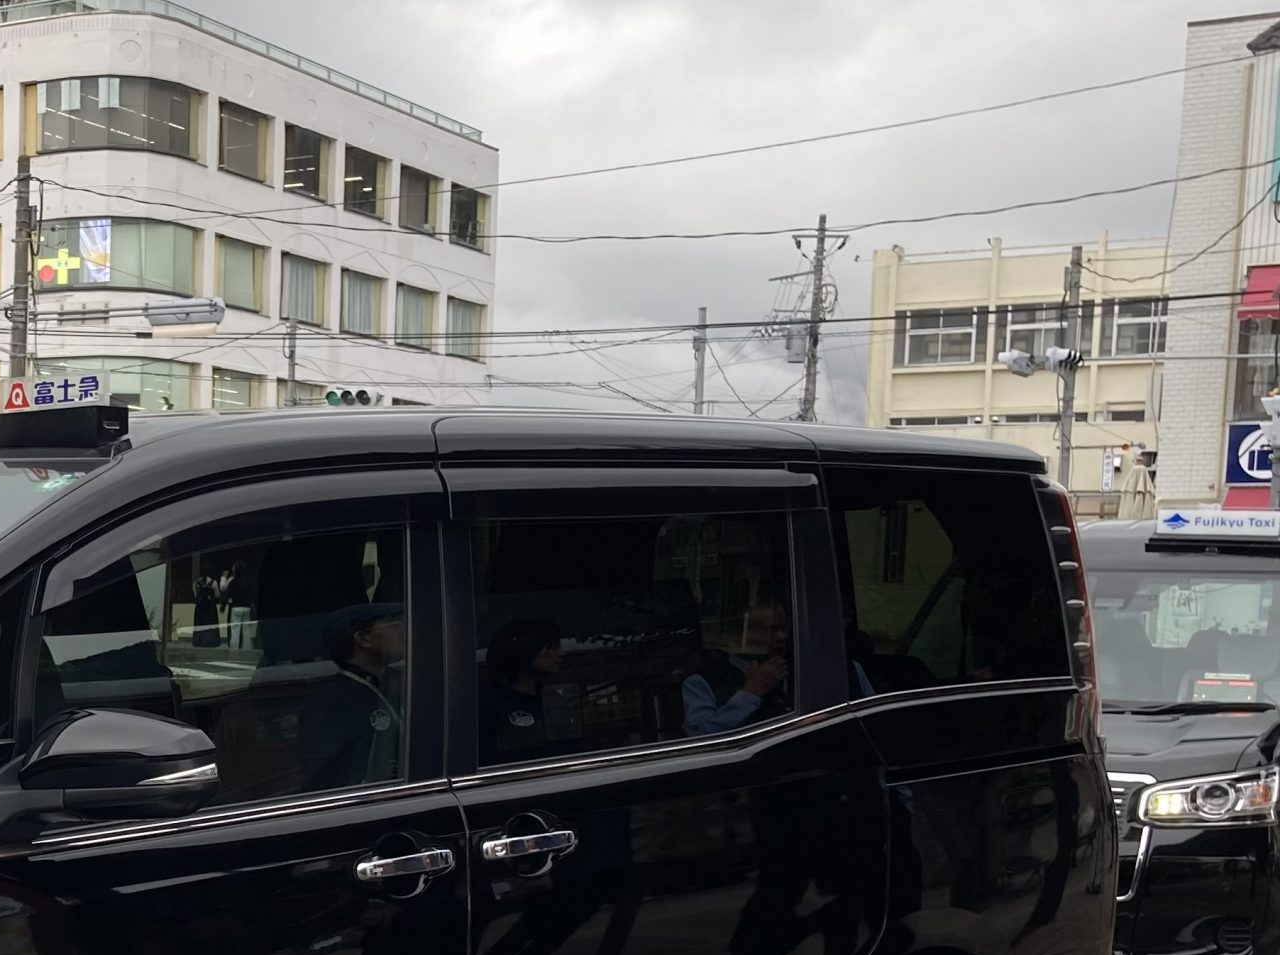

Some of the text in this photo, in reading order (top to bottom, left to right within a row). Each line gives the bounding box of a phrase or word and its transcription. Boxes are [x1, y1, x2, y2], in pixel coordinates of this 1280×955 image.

[34, 375, 99, 405] 富士急
[1194, 516, 1275, 528] Fujikyu Taxi
